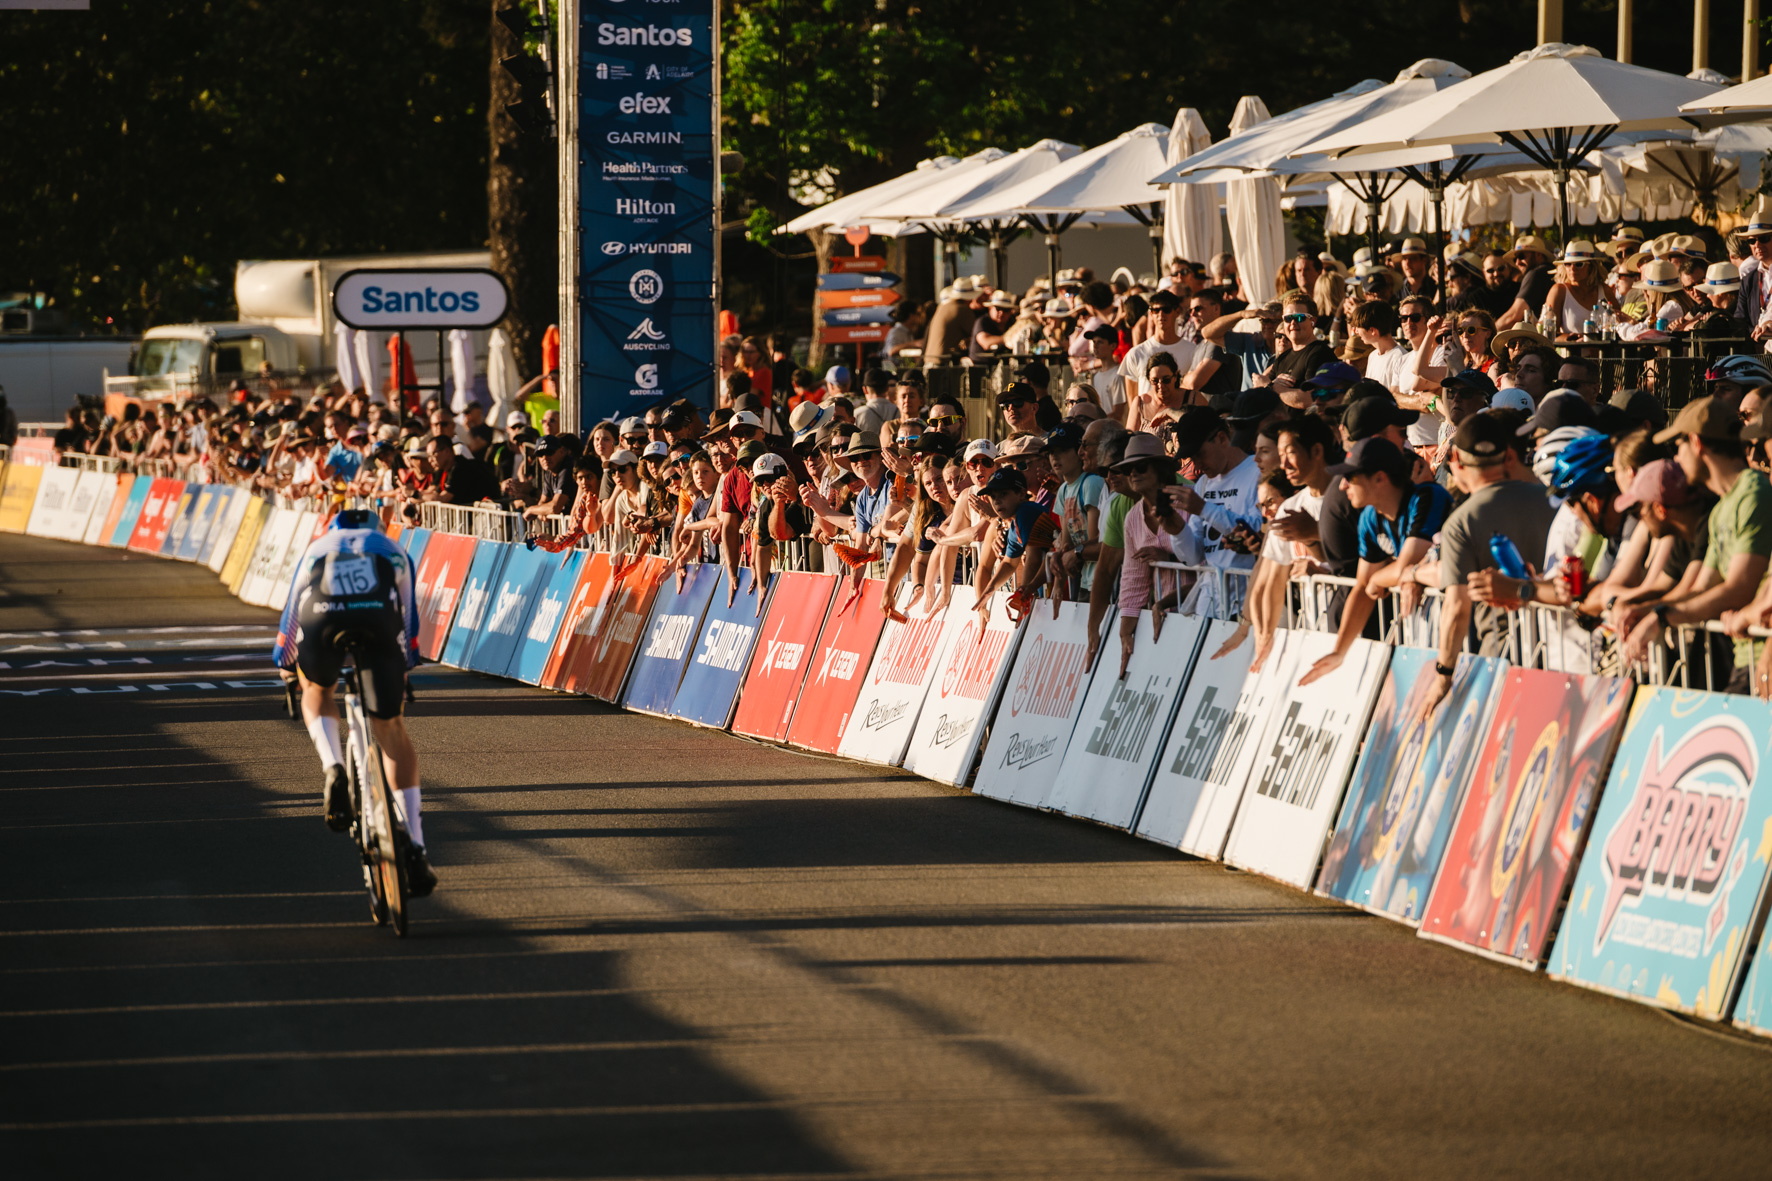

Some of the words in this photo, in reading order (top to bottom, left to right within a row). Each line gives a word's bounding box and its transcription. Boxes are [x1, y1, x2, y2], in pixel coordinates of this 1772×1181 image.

[598, 23, 693, 46] Santos
[619, 92, 671, 114] efex
[607, 131, 682, 144] GARMIN
[602, 161, 641, 174] Health
[641, 161, 689, 174] Partners
[616, 198, 676, 215] Hilton
[629, 243, 692, 254] HYUNDAI
[362, 285, 480, 314] Santos
[623, 343, 671, 351] AUSCYCLING
[1218, 488, 1239, 499] YOUR
[334, 568, 369, 595] 115
[312, 601, 346, 614] BORA
[487, 580, 527, 636] Santos
[527, 586, 562, 643] Santos
[644, 613, 695, 660] SHIMANO
[697, 619, 755, 672] SHIMANO
[885, 617, 945, 686] YAMAHA
[774, 641, 805, 671] LEGEND
[829, 648, 860, 681] LEGEND
[953, 627, 1010, 701] YAMAHA
[0, 679, 287, 696] YUND
[1025, 640, 1089, 720] YAMAHA
[1085, 671, 1172, 763] Santini
[1170, 685, 1264, 787] Santini
[1256, 701, 1351, 810] Santini
[1619, 784, 1745, 893] BARRY
